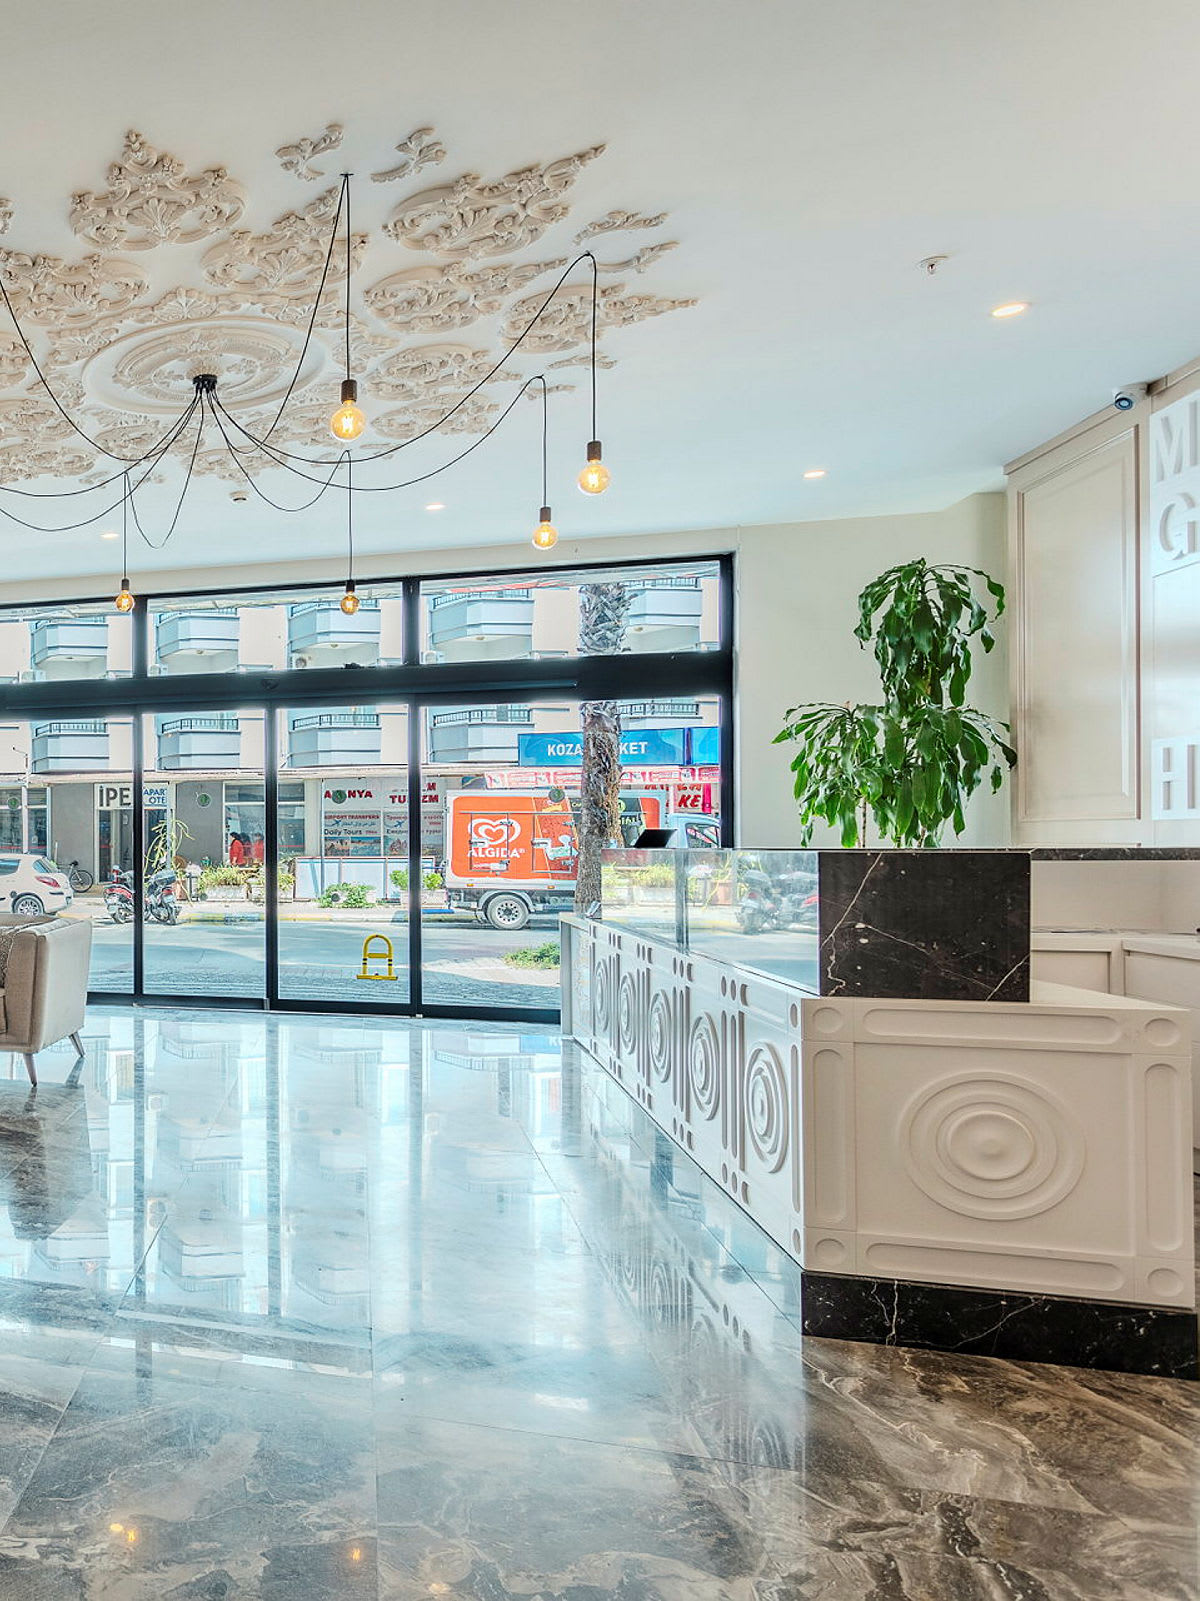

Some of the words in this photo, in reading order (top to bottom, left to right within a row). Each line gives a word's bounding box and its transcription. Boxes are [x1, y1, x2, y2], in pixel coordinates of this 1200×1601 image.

[547, 743, 583, 756] KOZA
[99, 785, 131, 807] İPE
[324, 790, 373, 799] ANYA
[389, 794, 439, 804] TUZM
[148, 796, 167, 804] OTE
[324, 828, 342, 836] Daily
